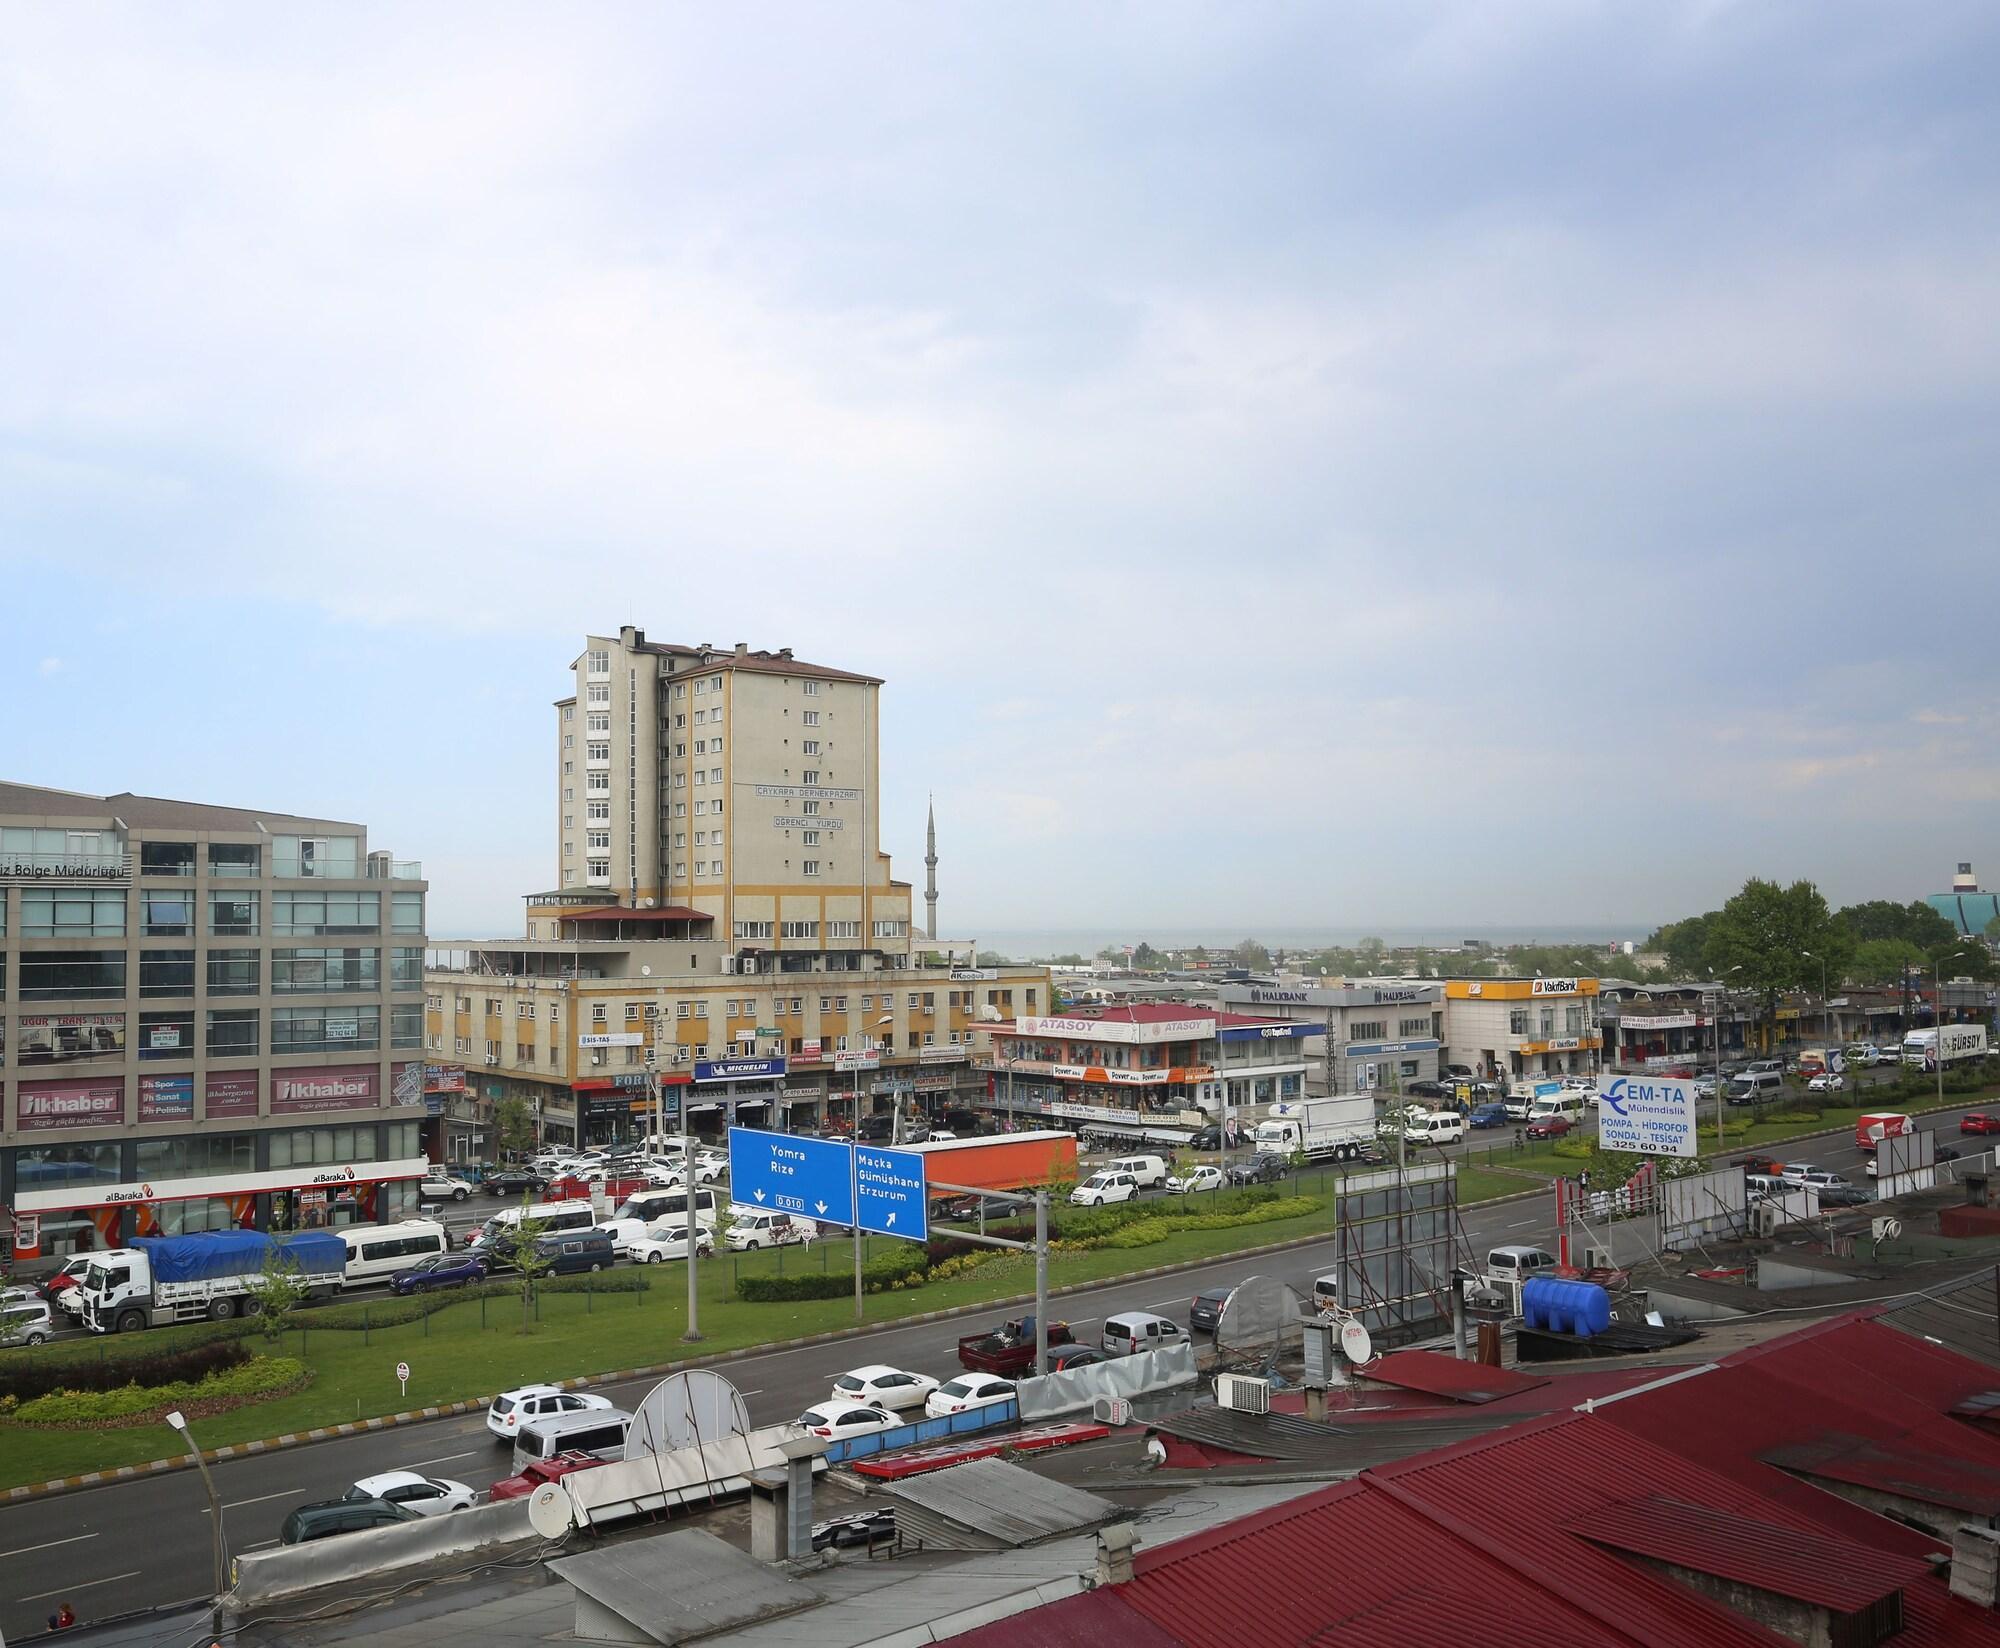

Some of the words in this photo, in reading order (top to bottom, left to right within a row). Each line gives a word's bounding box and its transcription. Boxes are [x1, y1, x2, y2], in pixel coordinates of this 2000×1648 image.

[15, 865, 51, 879] Bölge
[55, 865, 124, 880] Müdürlüğü
[1263, 992, 1308, 1001] HALKBANK
[58, 1016, 87, 1025] TRANS
[1040, 1019, 1095, 1032] ATASOY
[1165, 1021, 1202, 1032] ATASOY
[1952, 1033, 1981, 1051] GÜRSOY
[727, 1063, 768, 1072] MICHELIN
[155, 1080, 174, 1089] Spor
[282, 1081, 366, 1099] ilkhaber
[155, 1093, 179, 1101] Sanat
[26, 1095, 113, 1114] ilkhaber
[156, 1106, 186, 1114] Politika
[1628, 1104, 1686, 1116] Mühendislik
[1601, 1118, 1632, 1128] POMPA
[1642, 1119, 1688, 1133] HİDROFOR
[1606, 1130, 1640, 1141] SONDAJ
[1650, 1133, 1684, 1145] TESİSAT
[770, 1144, 806, 1161] Yomra
[1612, 1140, 1636, 1149] 325
[1640, 1143, 1657, 1151] 60
[1661, 1145, 1678, 1153] 94
[858, 1154, 892, 1169] Maçka
[771, 1162, 794, 1176] Rize
[313, 1172, 346, 1183] alBaraka
[859, 1169, 920, 1189] Gümüşhane
[106, 1190, 143, 1202] alBaraka
[859, 1184, 907, 1202] Erzurum
[778, 1196, 802, 1209] D.010
